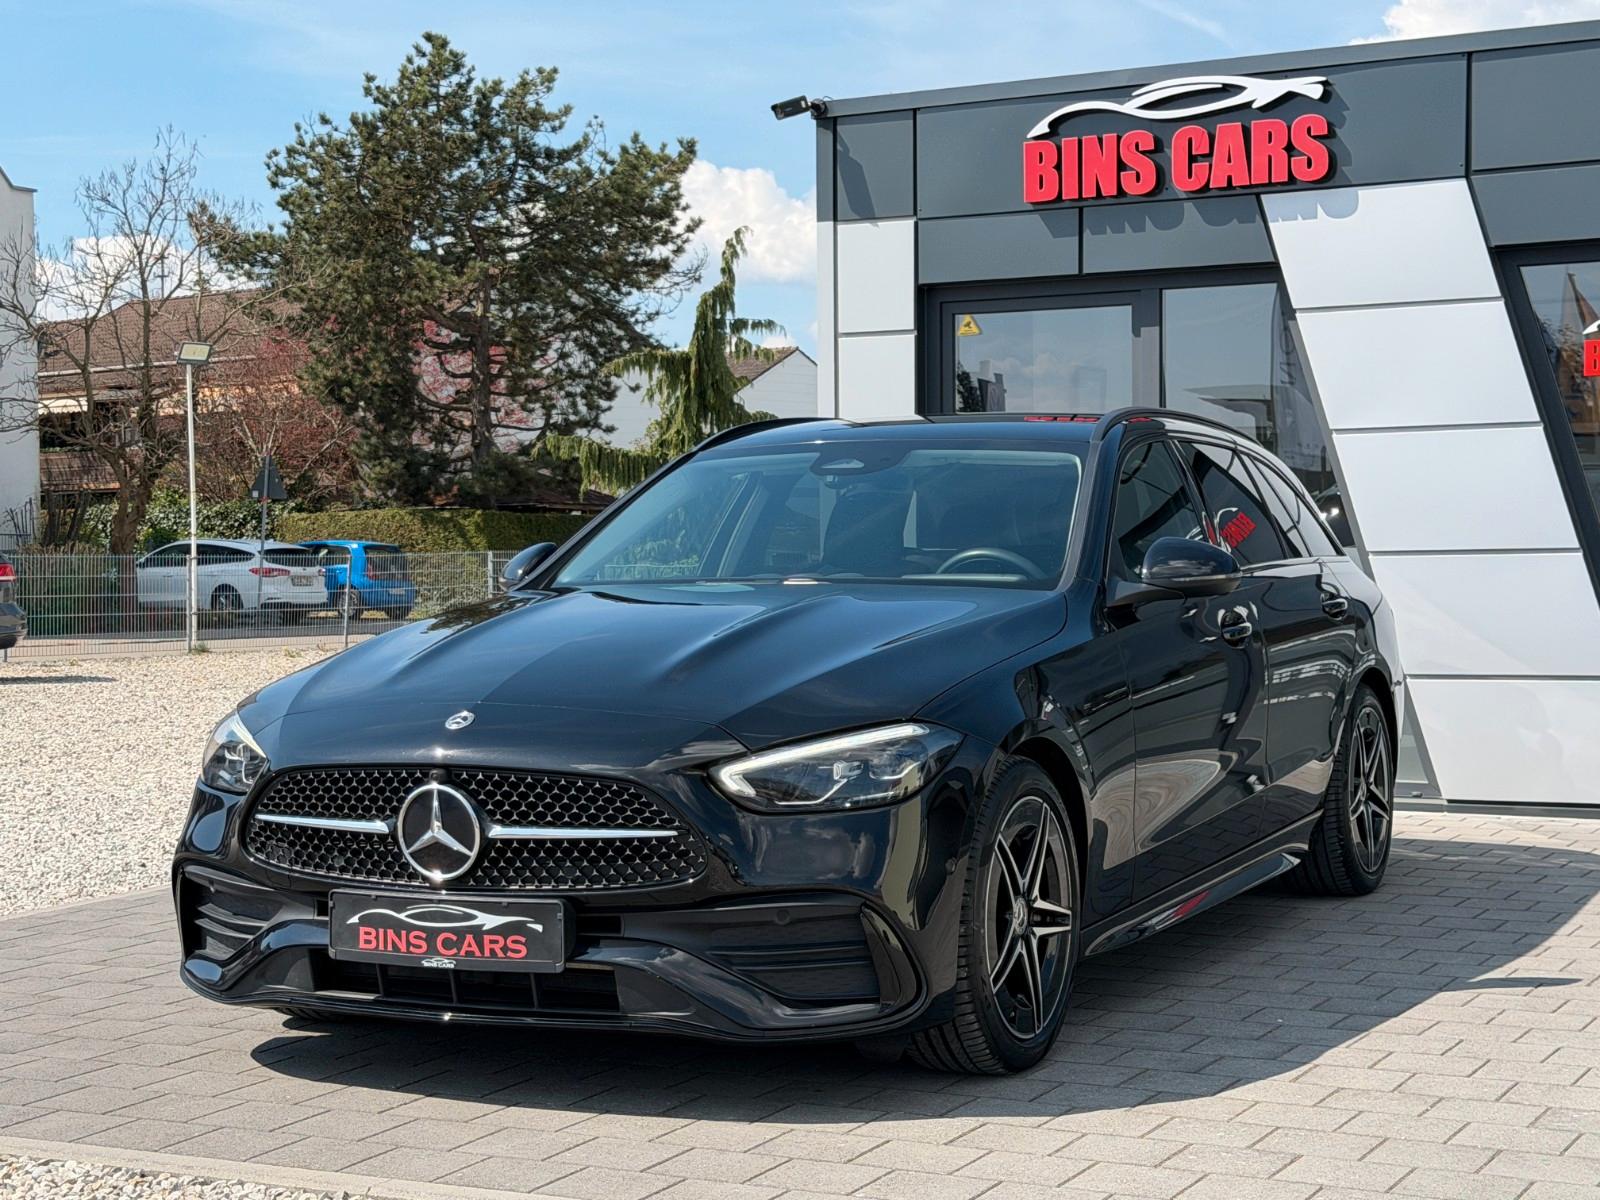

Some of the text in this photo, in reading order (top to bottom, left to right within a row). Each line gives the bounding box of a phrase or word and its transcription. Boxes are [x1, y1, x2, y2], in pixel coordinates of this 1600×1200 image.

[1023, 113, 1330, 203] BINS CARS
[358, 926, 528, 959] BINS CARS
